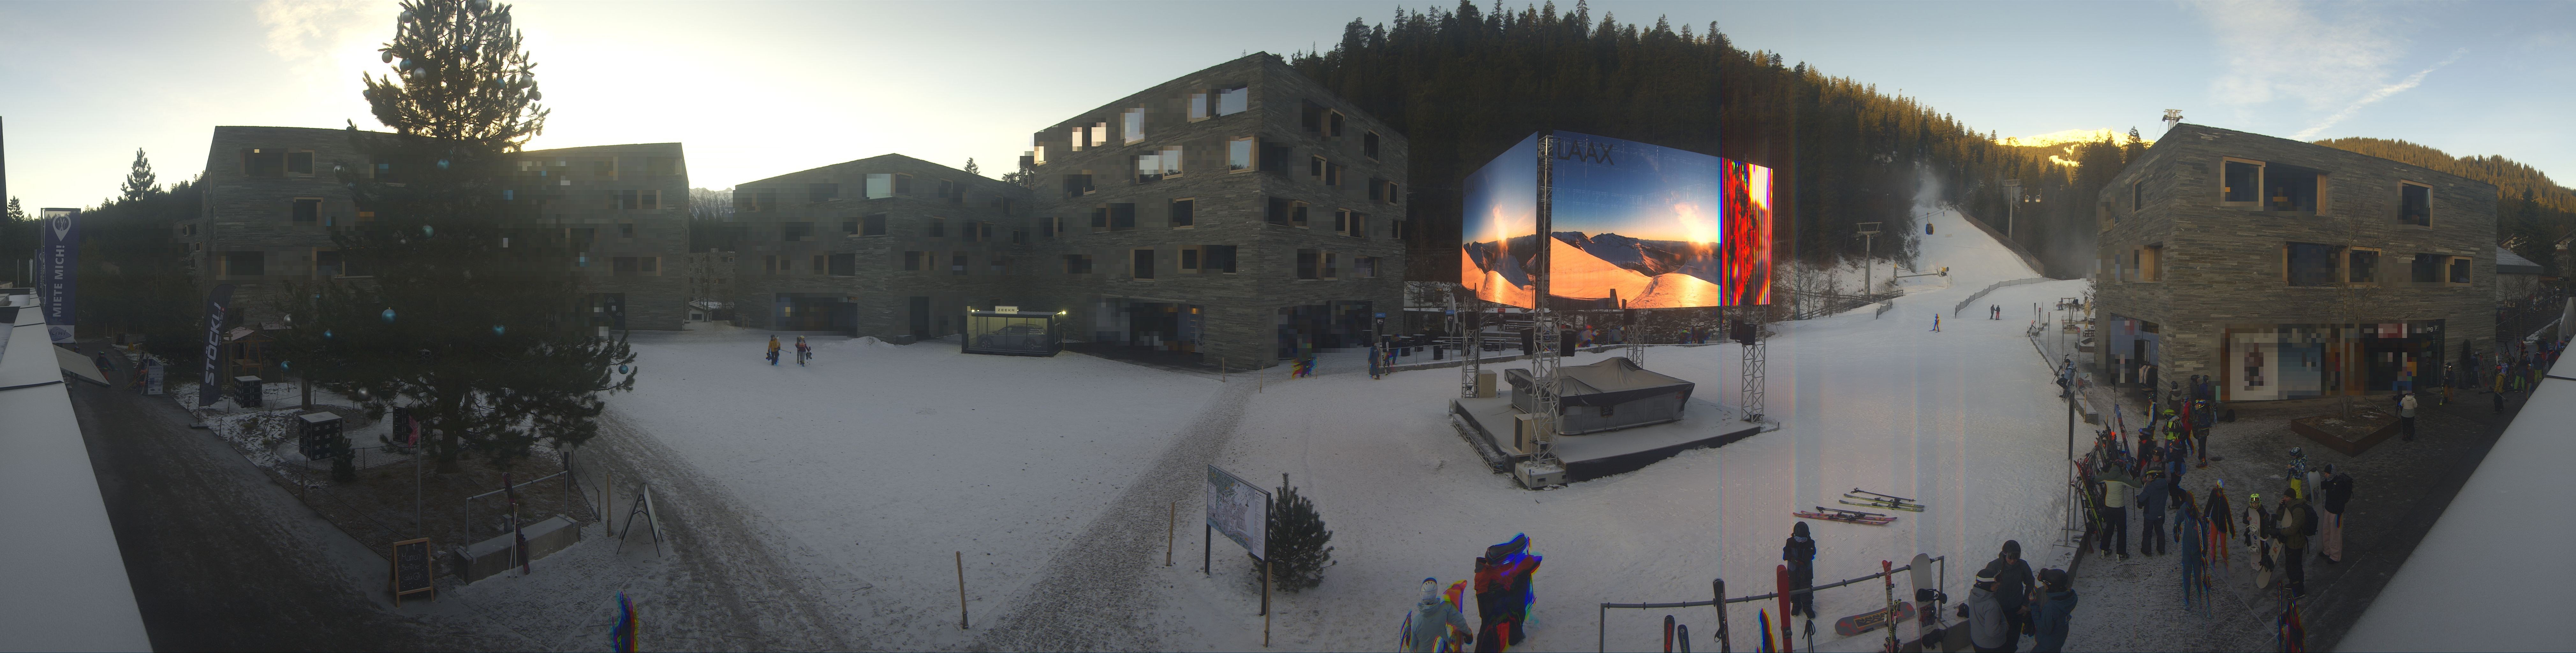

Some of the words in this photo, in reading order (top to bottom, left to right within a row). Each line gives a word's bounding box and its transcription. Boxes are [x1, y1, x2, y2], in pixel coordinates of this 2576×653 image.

[1557, 137, 1614, 165] LAAX
[55, 245, 65, 279] MICH!
[53, 283, 63, 317] MIETE
[205, 302, 221, 386] STÖCKLI
